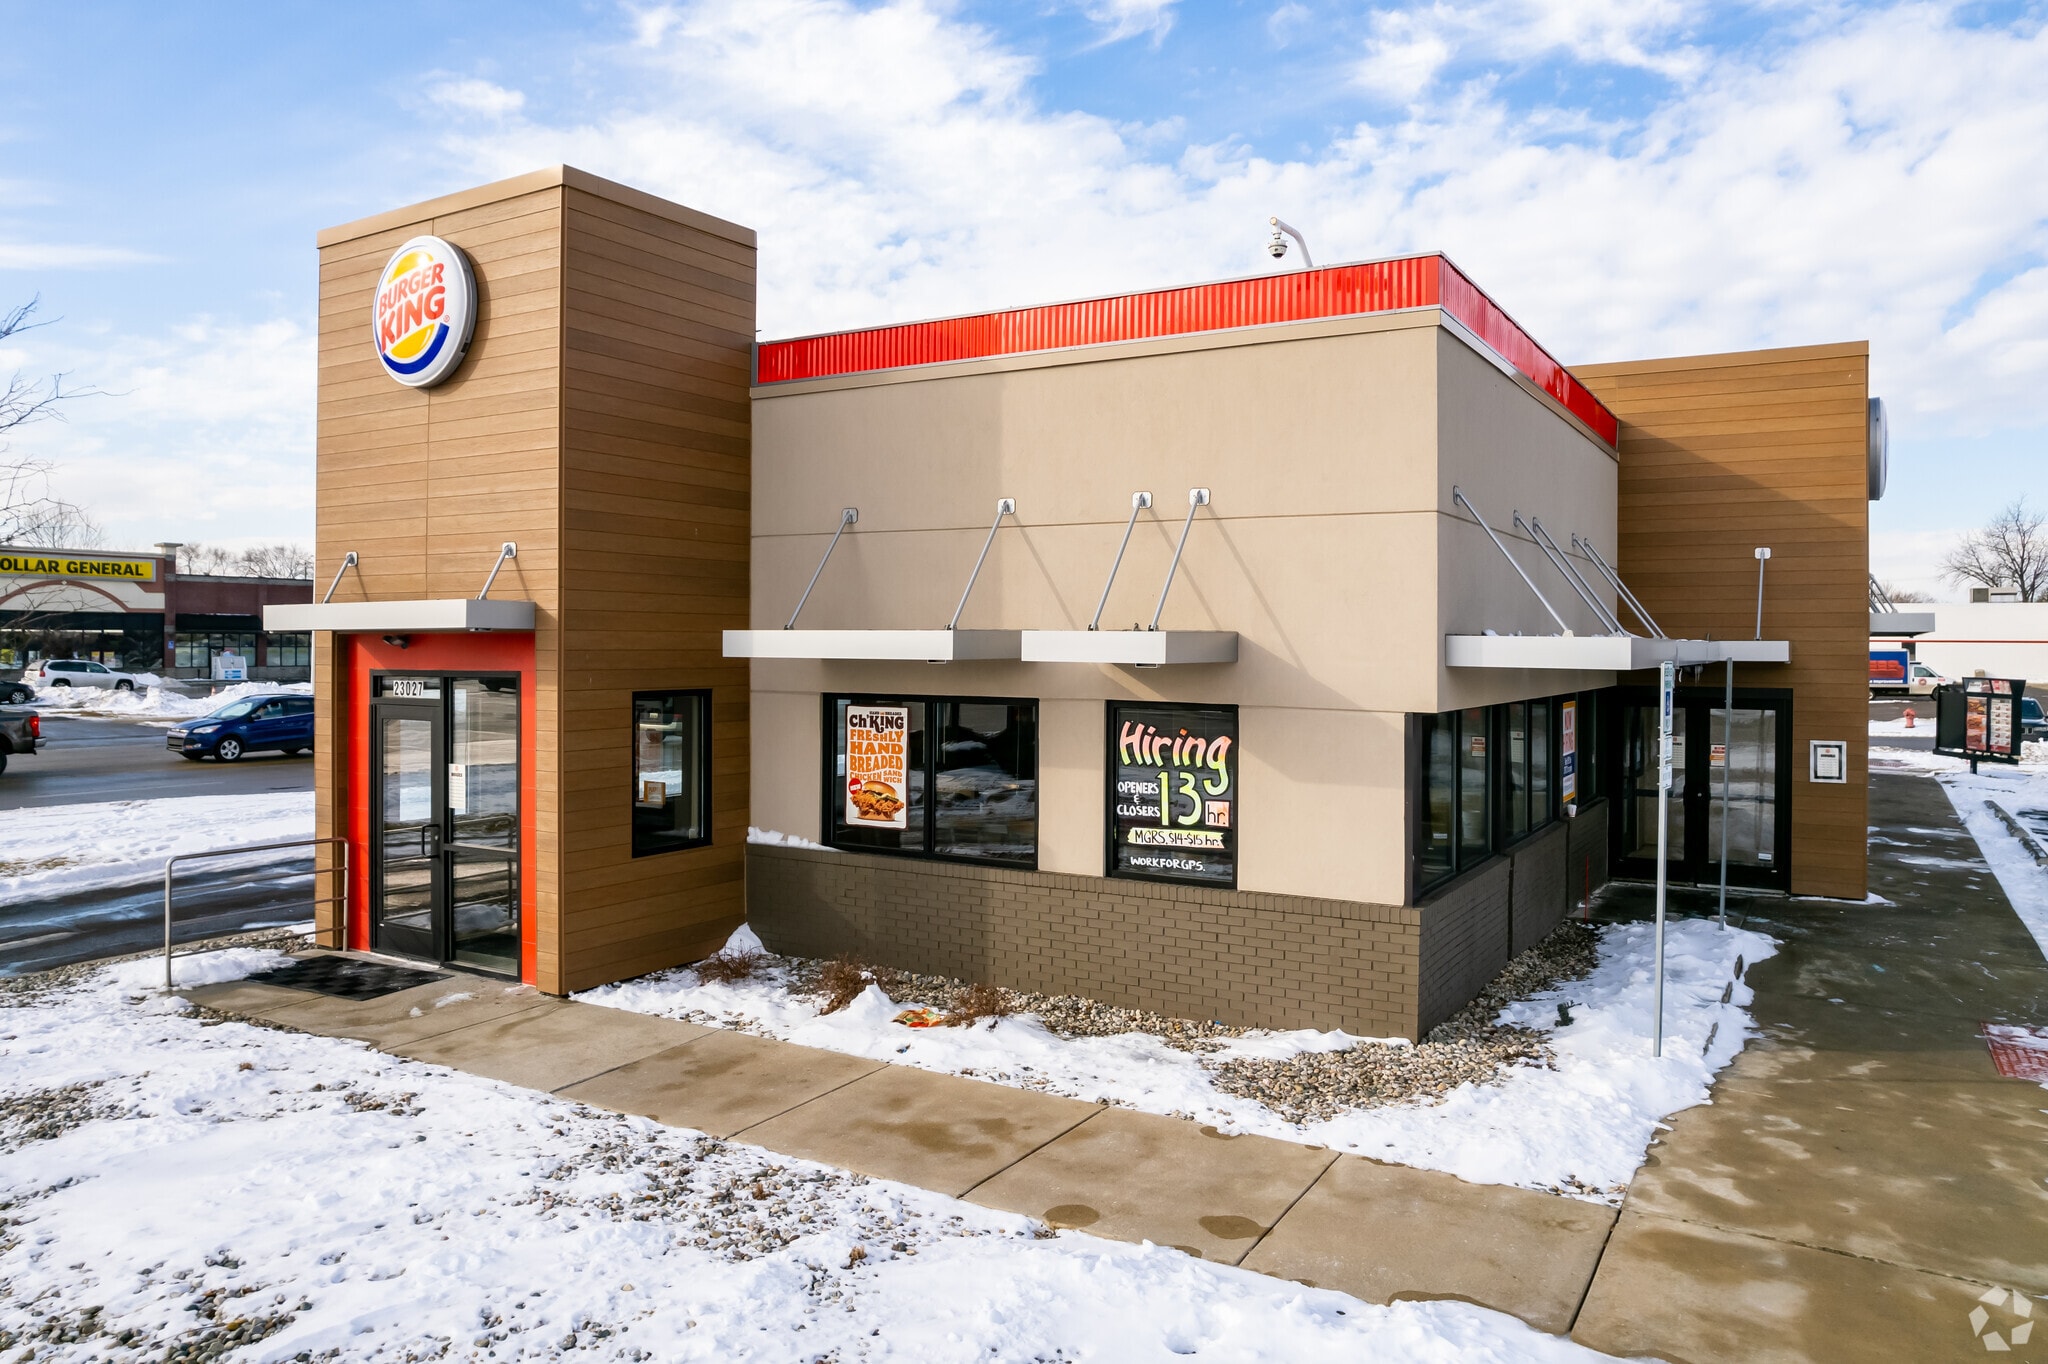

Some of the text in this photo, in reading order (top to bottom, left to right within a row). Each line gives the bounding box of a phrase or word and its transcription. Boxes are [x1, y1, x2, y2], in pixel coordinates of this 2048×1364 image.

[378, 262, 445, 320] BURGER
[380, 285, 446, 354] KING
[0, 557, 144, 577] OLLAR GENERAL
[394, 681, 422, 696] 23027
[850, 729, 904, 742] FRESHLY
[850, 741, 903, 755] HAND
[850, 755, 903, 773] BREADED
[1119, 720, 1232, 796] Hiring
[850, 769, 903, 782] CHICKEN SAND
[1117, 781, 1159, 794] OPENERS
[1157, 771, 1202, 826] 13
[1116, 804, 1160, 817] CLOSERS
